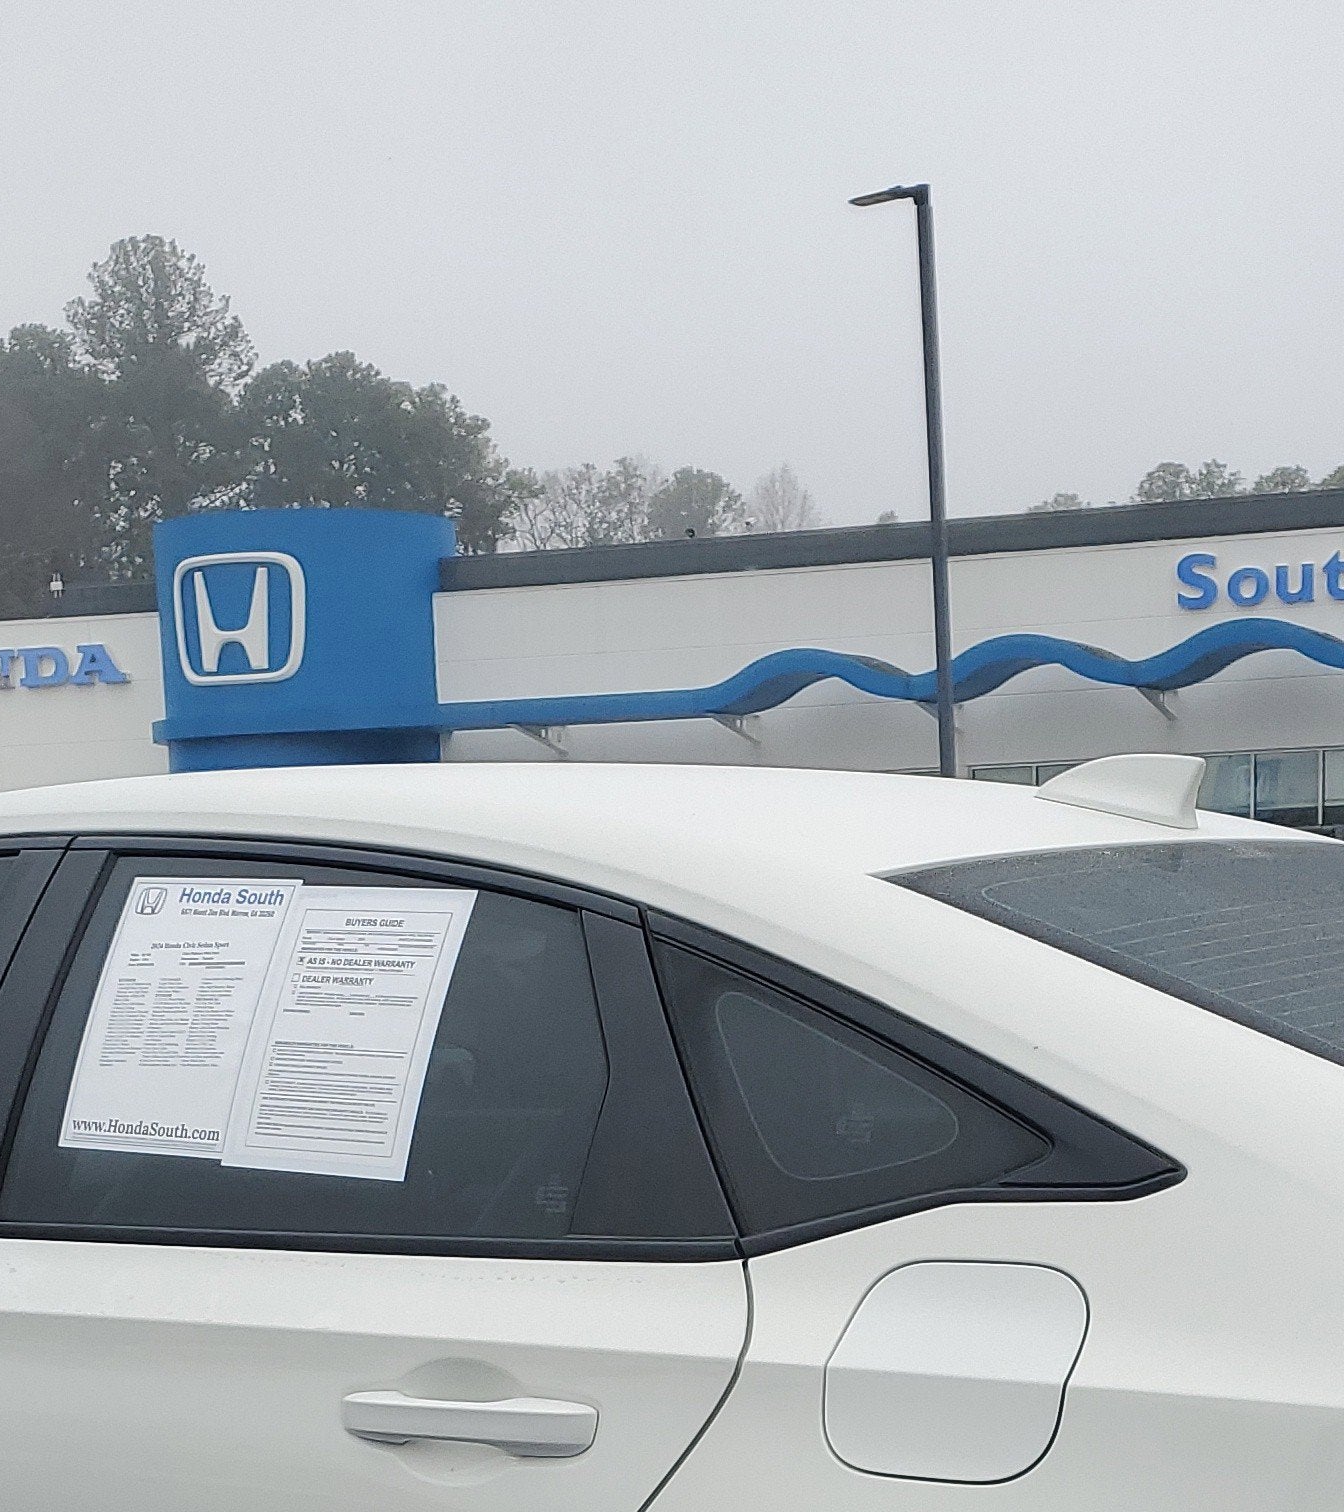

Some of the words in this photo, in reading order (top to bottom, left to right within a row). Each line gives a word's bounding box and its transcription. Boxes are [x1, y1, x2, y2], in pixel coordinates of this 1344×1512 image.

[179, 887, 232, 904] Honda
[235, 888, 285, 906] South
[345, 918, 378, 927] BUYERS
[379, 919, 405, 928] GUIDE
[307, 957, 317, 965] AS
[317, 957, 326, 966] IS
[331, 958, 343, 966] NO
[342, 958, 373, 967] DEALER
[373, 960, 416, 969] WARRANTY
[301, 975, 332, 984] DEALER
[332, 976, 375, 986] WARRANTY
[72, 1118, 220, 1142] www.HondaSouth.com
